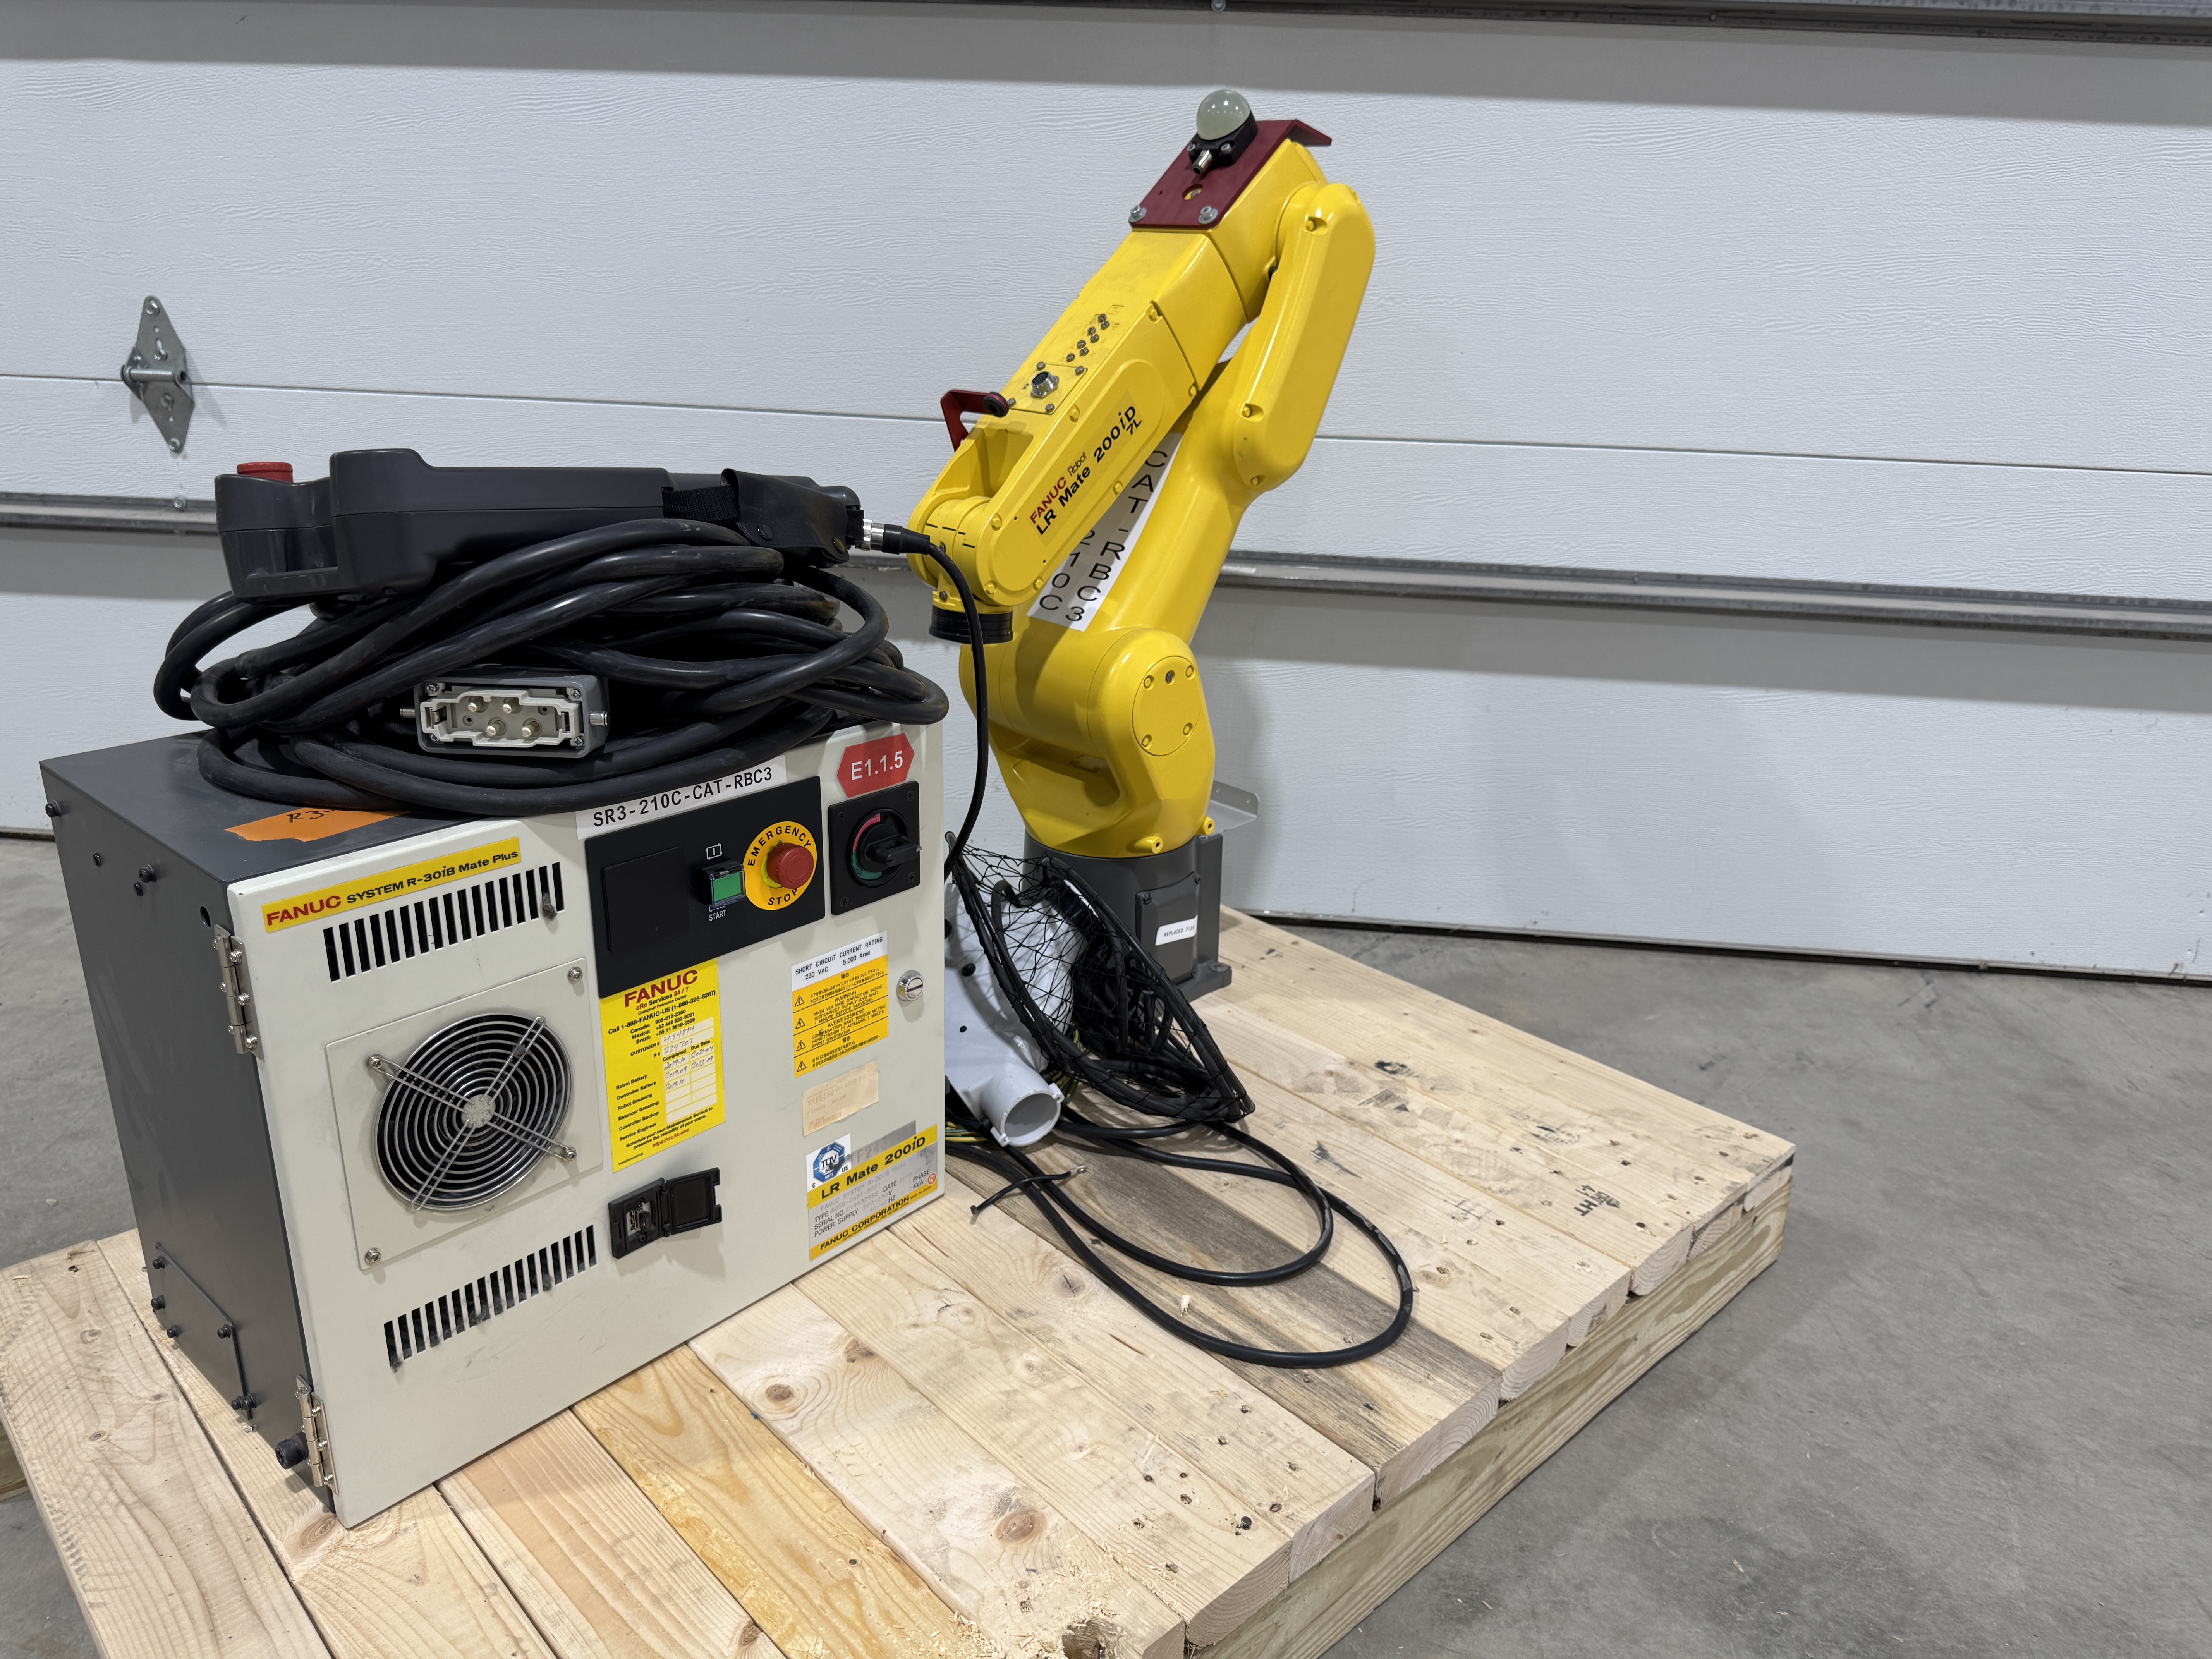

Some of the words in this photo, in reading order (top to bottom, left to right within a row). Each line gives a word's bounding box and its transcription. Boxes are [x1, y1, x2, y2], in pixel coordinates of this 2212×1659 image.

[1126, 419, 1142, 435] 7L
[1036, 512, 1057, 535] LR
[1059, 467, 1091, 507] Mate
[1094, 406, 1136, 463] 200iD
[1030, 477, 1068, 525] FANUC
[1067, 452, 1087, 477] Robot
[851, 750, 903, 780] E1.1.5
[593, 767, 773, 827] SR3-210C-CAT-RBC3
[287, 809, 335, 823] R3
[748, 825, 811, 867] EMERGENCY
[267, 895, 342, 926] FANUC
[347, 881, 404, 903] SYSTEM
[407, 865, 455, 888] R-30iB
[459, 857, 489, 876] Mate
[493, 850, 519, 865] Plus
[768, 887, 798, 906] STOP
[709, 910, 726, 921] START
[796, 963, 812, 975] SHORT
[816, 954, 836, 967] CIRCUIT
[840, 945, 862, 958] CURRENT
[865, 936, 883, 948] RATING
[805, 971, 815, 980] 230
[818, 967, 828, 975] VAC
[624, 969, 699, 1007] FANUC
[826, 1000, 844, 1011] VOLTAGE
[846, 990, 868, 1003] CAPACITOR
[870, 984, 882, 992] INSIDE
[835, 989, 856, 1003] WARNING
[649, 993, 673, 1005] Services
[621, 1008, 670, 1029] 1-888-FANUC-US
[814, 1006, 840, 1020] DISCONNECT
[842, 999, 857, 1009] SUPPLY
[819, 1014, 833, 1023] MINUTE
[836, 1006, 851, 1016] BEFORE
[853, 997, 872, 1009] SERVICING
[828, 1008, 864, 1028] AVERTISSEMENT
[630, 1023, 650, 1033] Canada:
[812, 1023, 842, 1040] CONENSATEUR
[843, 1018, 853, 1026] HAUT
[855, 1010, 870, 1020] TENSION
[872, 1004, 886, 1013] METTRE
[812, 1036, 822, 1044] HORS
[824, 1029, 839, 1039] TENSION
[871, 1009, 884, 1018] MINUTE
[632, 1029, 651, 1039] Mexico:
[812, 1039, 824, 1048] AVANT
[630, 1043, 656, 1056] CUSTOMER
[663, 1049, 686, 1062] Completed
[616, 1081, 630, 1090] Robot
[631, 1074, 647, 1084] Battery
[617, 1088, 639, 1100] Controller
[640, 1081, 656, 1091] Battery
[617, 1102, 632, 1111] Robot
[632, 1093, 652, 1105] Greasing
[618, 1109, 638, 1121] Balancer
[639, 1101, 659, 1112] Greasing
[619, 1119, 641, 1131] Controller
[620, 1131, 636, 1141] Service
[637, 1122, 657, 1134] Engineer
[821, 1182, 840, 1199] LR
[847, 1161, 878, 1185] Mate
[884, 1132, 925, 1165] 200iD
[913, 1180, 923, 1189] KVA
[814, 1222, 835, 1237] POWER
[838, 1209, 858, 1224] SUPPLY
[913, 1169, 929, 1182] PHASE
[814, 1216, 834, 1230] SERIAL
[835, 1209, 845, 1218] NO.
[883, 1181, 896, 1192] DATE
[814, 1211, 828, 1223] TYPE
[820, 1230, 848, 1250] FANUC
[852, 1196, 909, 1232] CORPORATION
